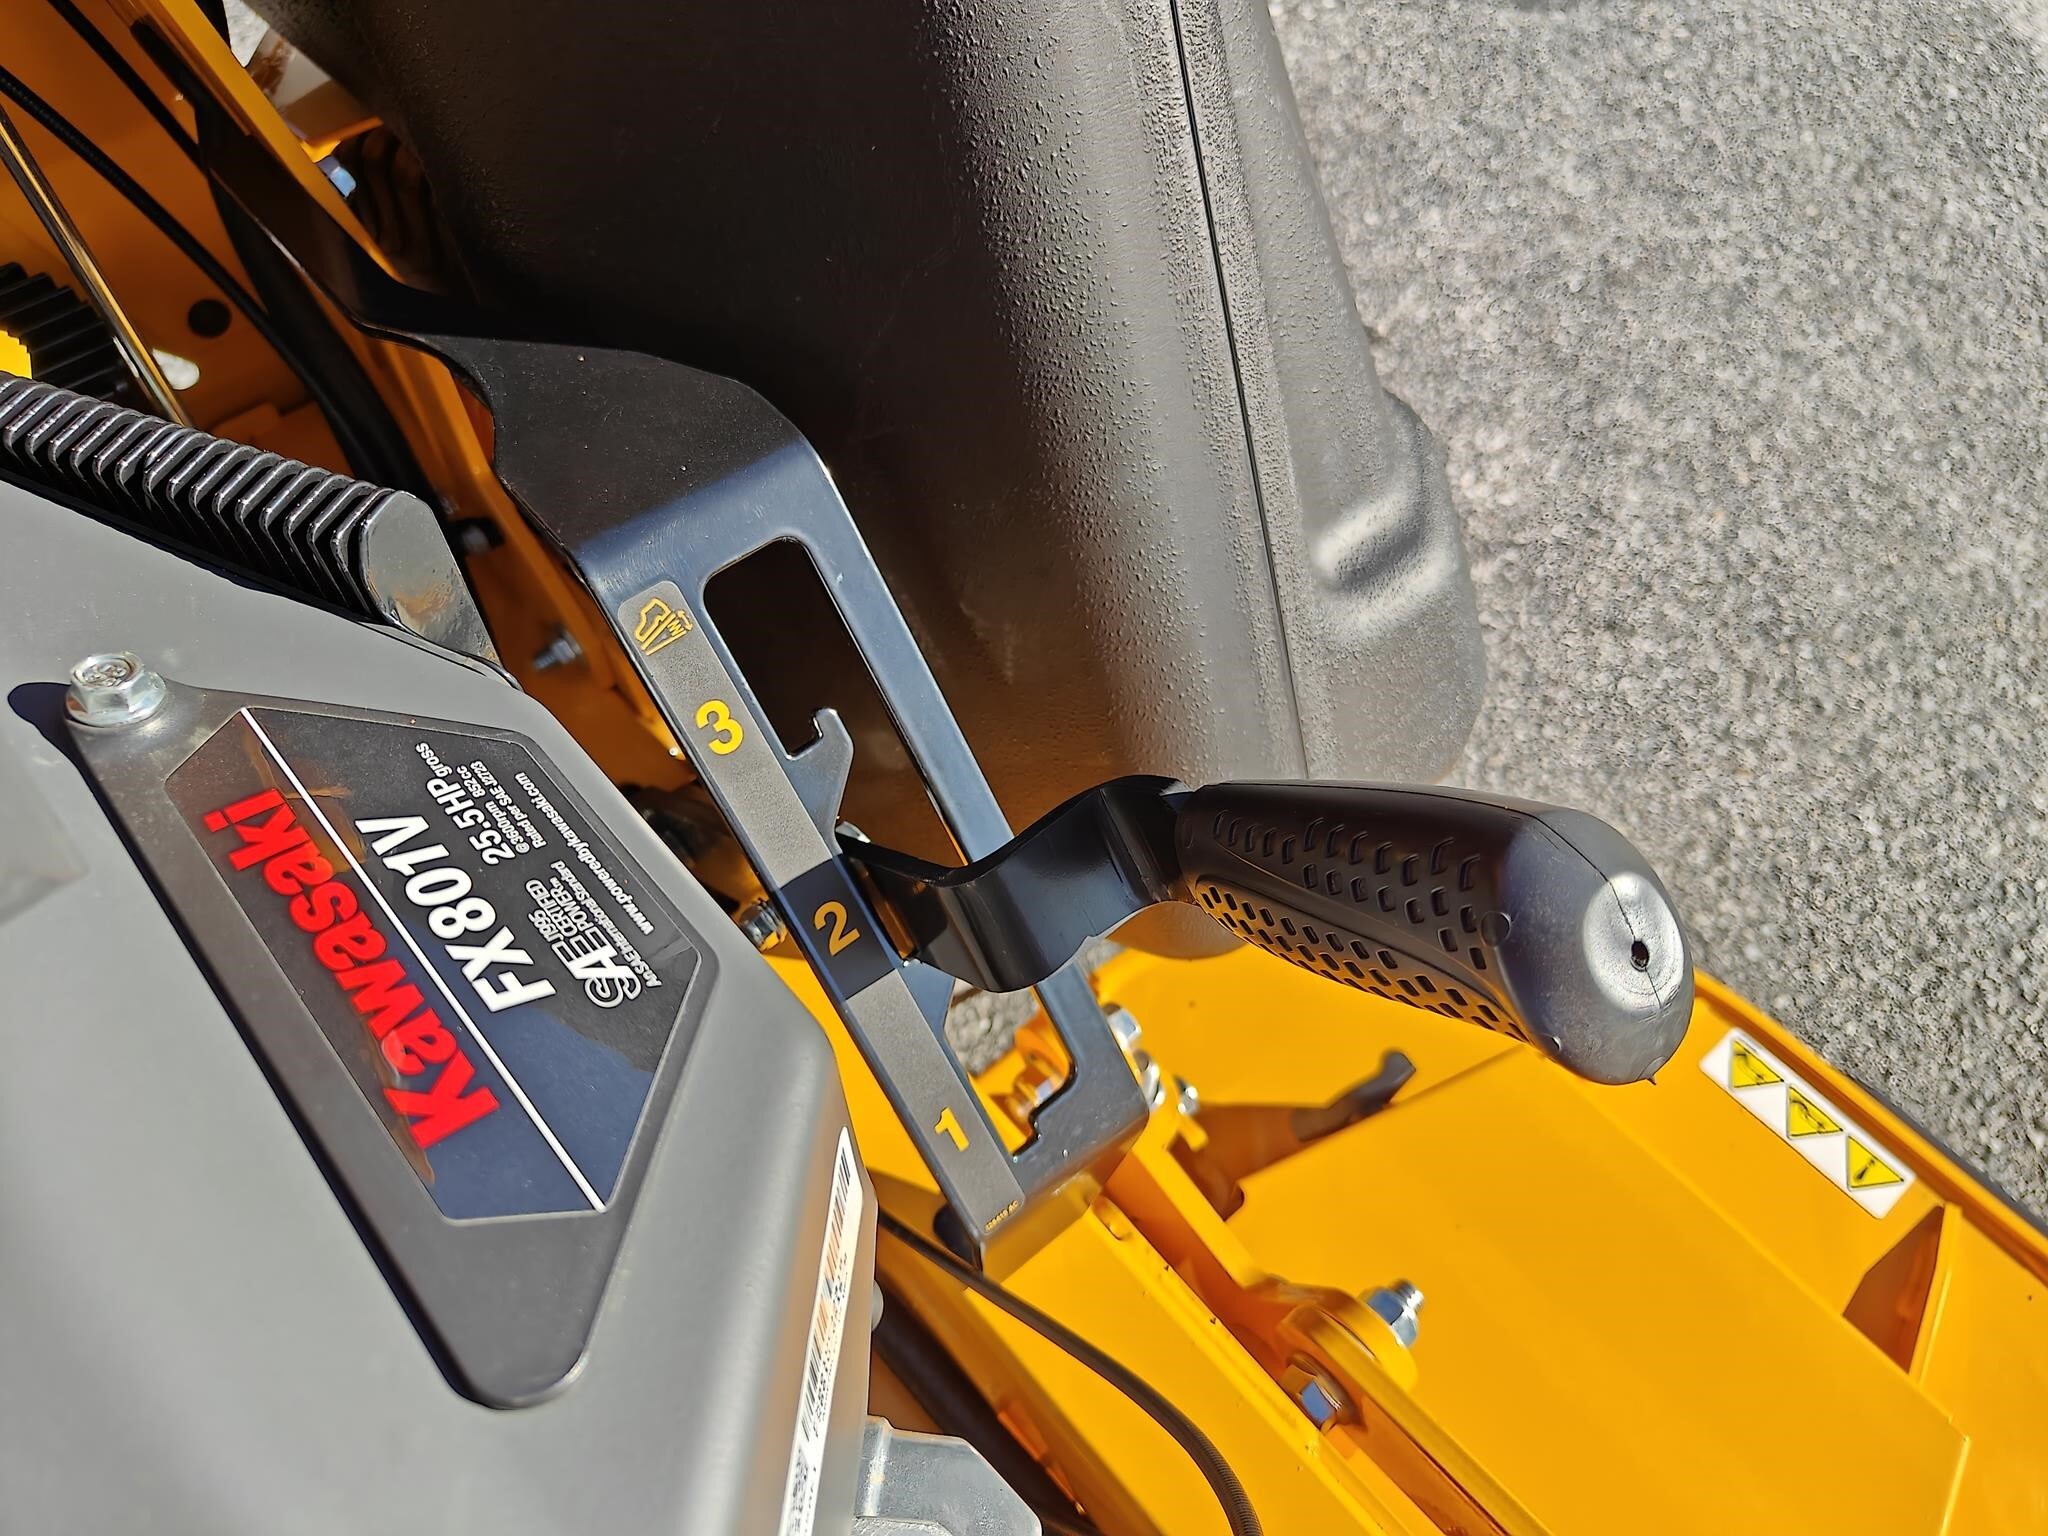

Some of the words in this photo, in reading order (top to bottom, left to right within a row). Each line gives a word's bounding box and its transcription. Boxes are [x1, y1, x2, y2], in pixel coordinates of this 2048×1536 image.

[694, 700, 744, 755] 3
[415, 742, 453, 778] gross
[470, 760, 498, 787] J2723
[489, 784, 512, 806] SAE
[507, 804, 528, 827] per
[484, 801, 530, 854] @3600rpm
[517, 819, 547, 849] Rated
[514, 772, 654, 936] www.poweredbykawasaki.com
[550, 860, 590, 906] Standard
[354, 815, 557, 1013] FX801V
[525, 879, 578, 937] CERTIFIED
[528, 909, 564, 942] J1995
[585, 896, 630, 951] International
[813, 901, 860, 956] 2
[203, 787, 500, 1149] Kawasaki
[551, 926, 642, 1008] SAE
[622, 949, 650, 975] SAE
[642, 969, 662, 987] An
[934, 1107, 970, 1151] 1
